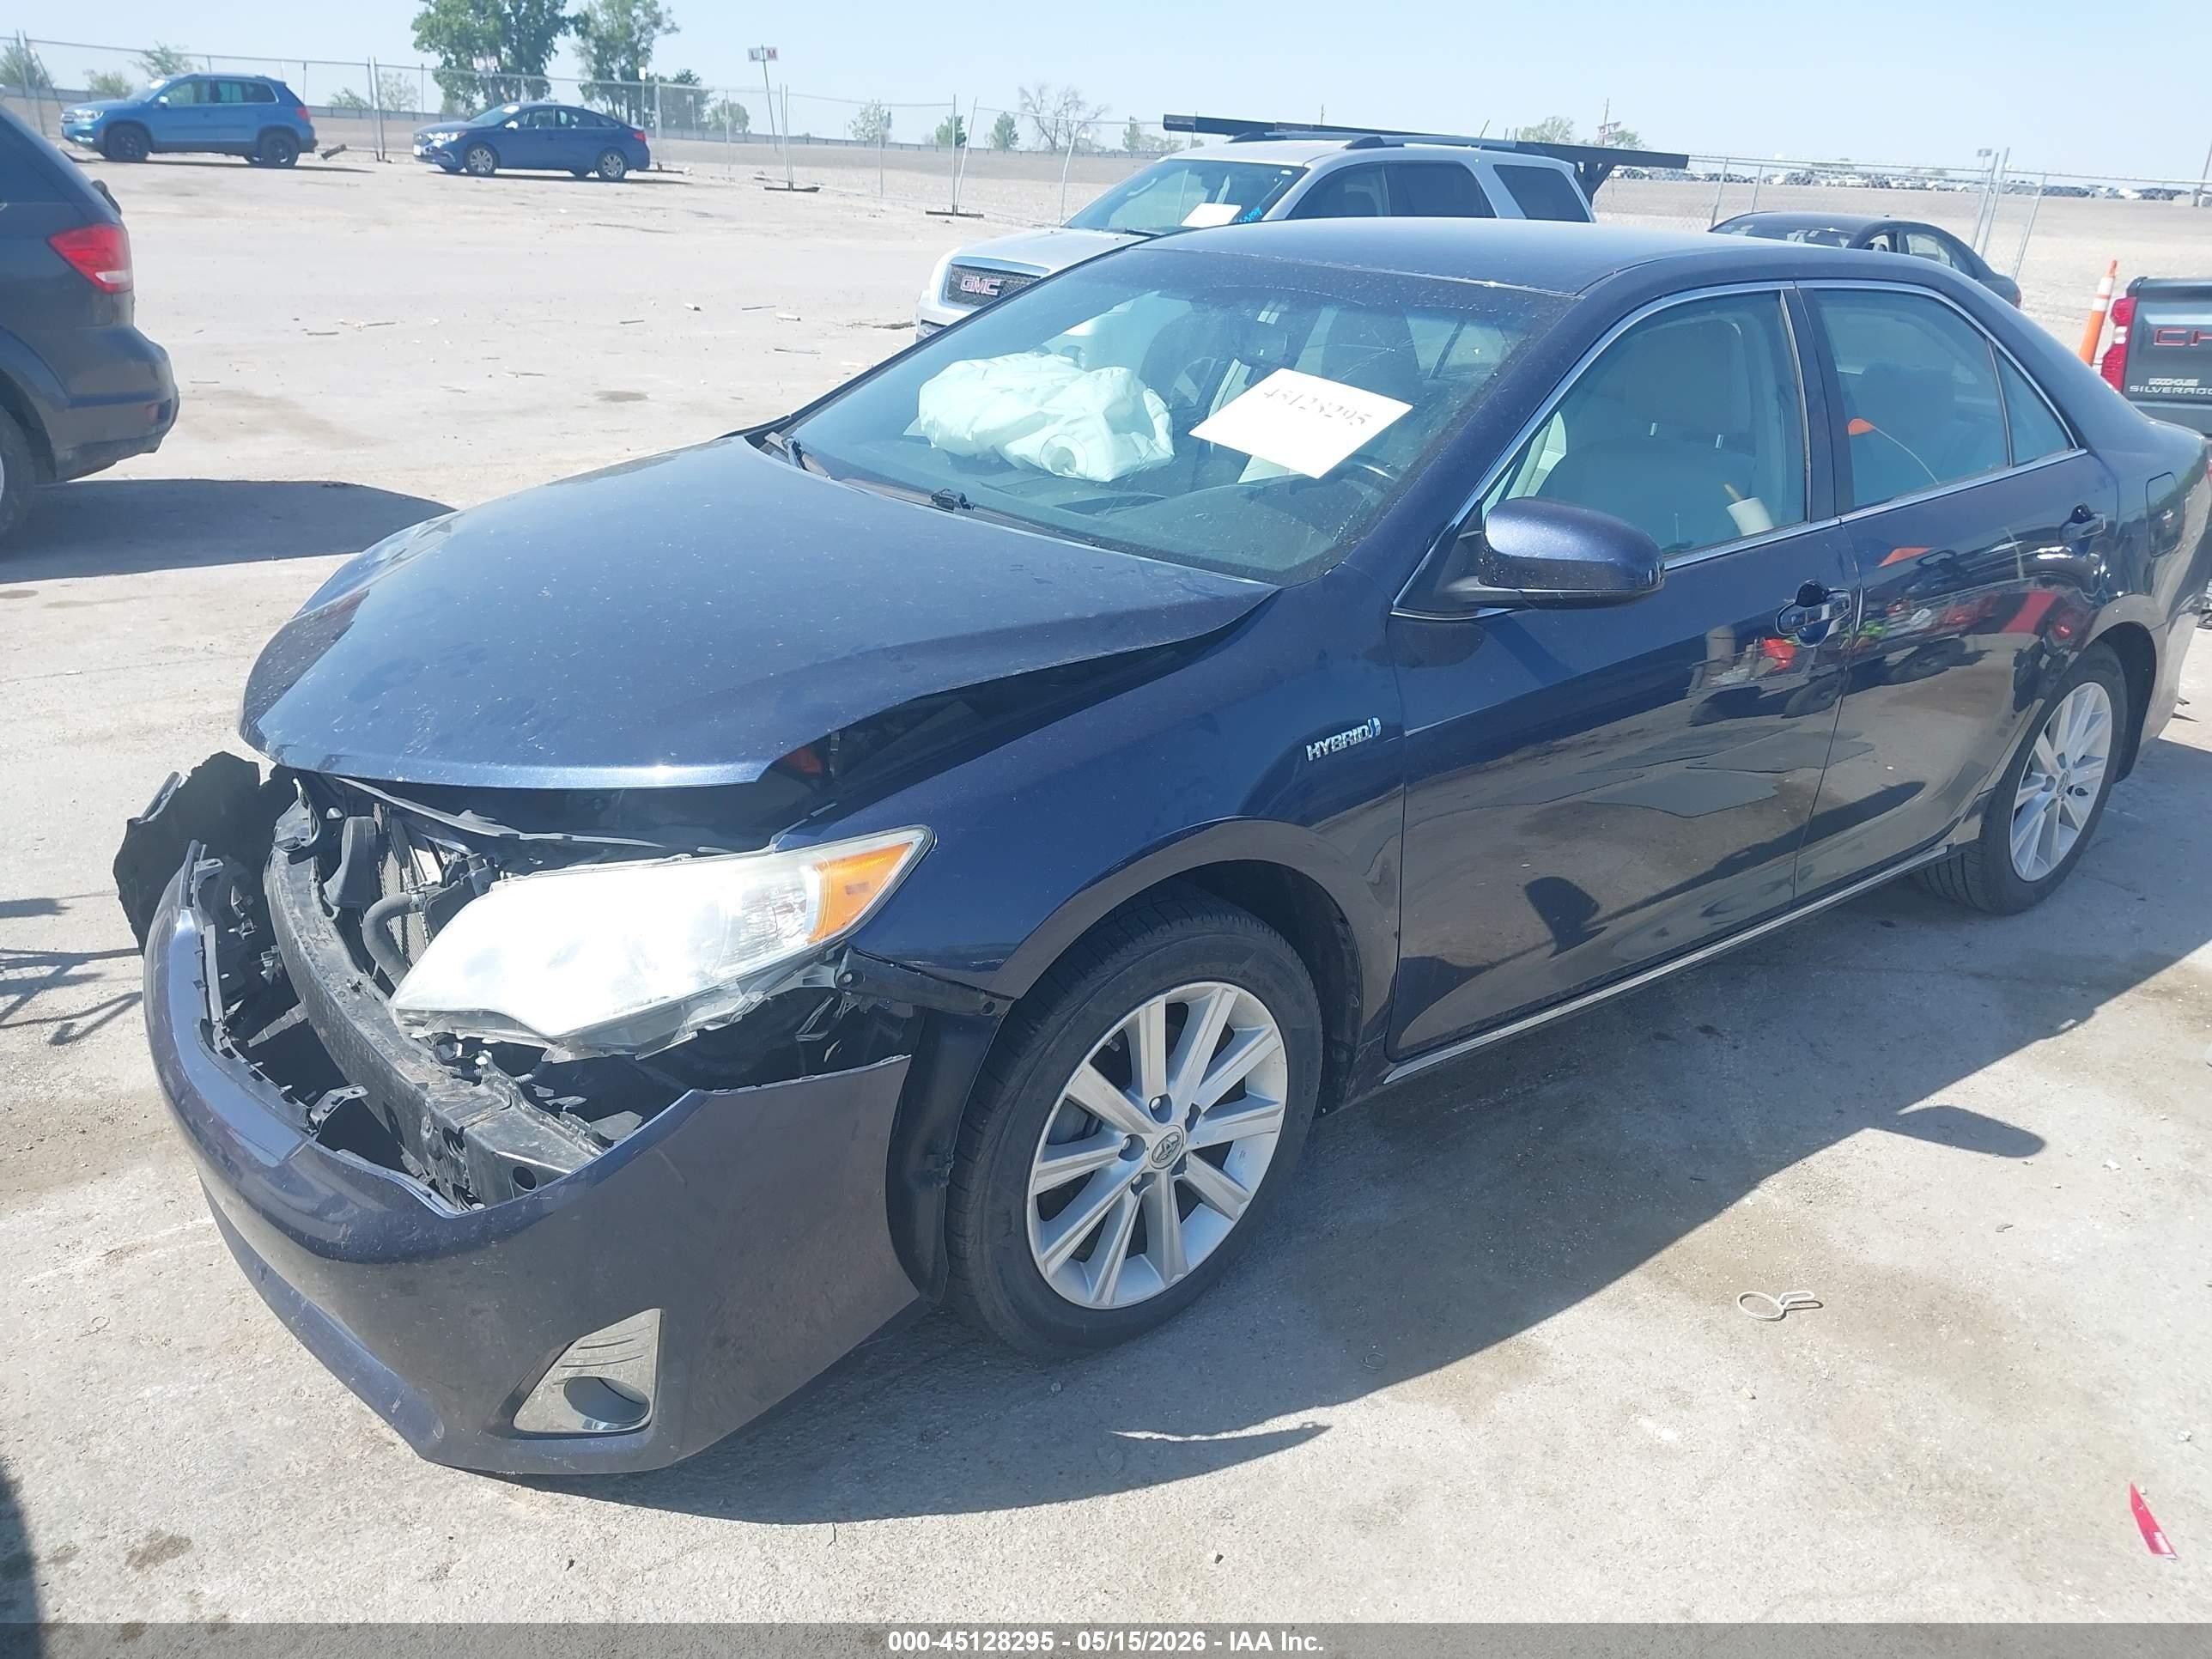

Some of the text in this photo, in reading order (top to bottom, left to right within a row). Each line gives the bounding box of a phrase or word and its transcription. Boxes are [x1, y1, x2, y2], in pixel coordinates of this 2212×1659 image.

[750, 50, 760, 60] L
[960, 276, 1001, 296] GMC
[1305, 724, 1370, 762] HYBRID
